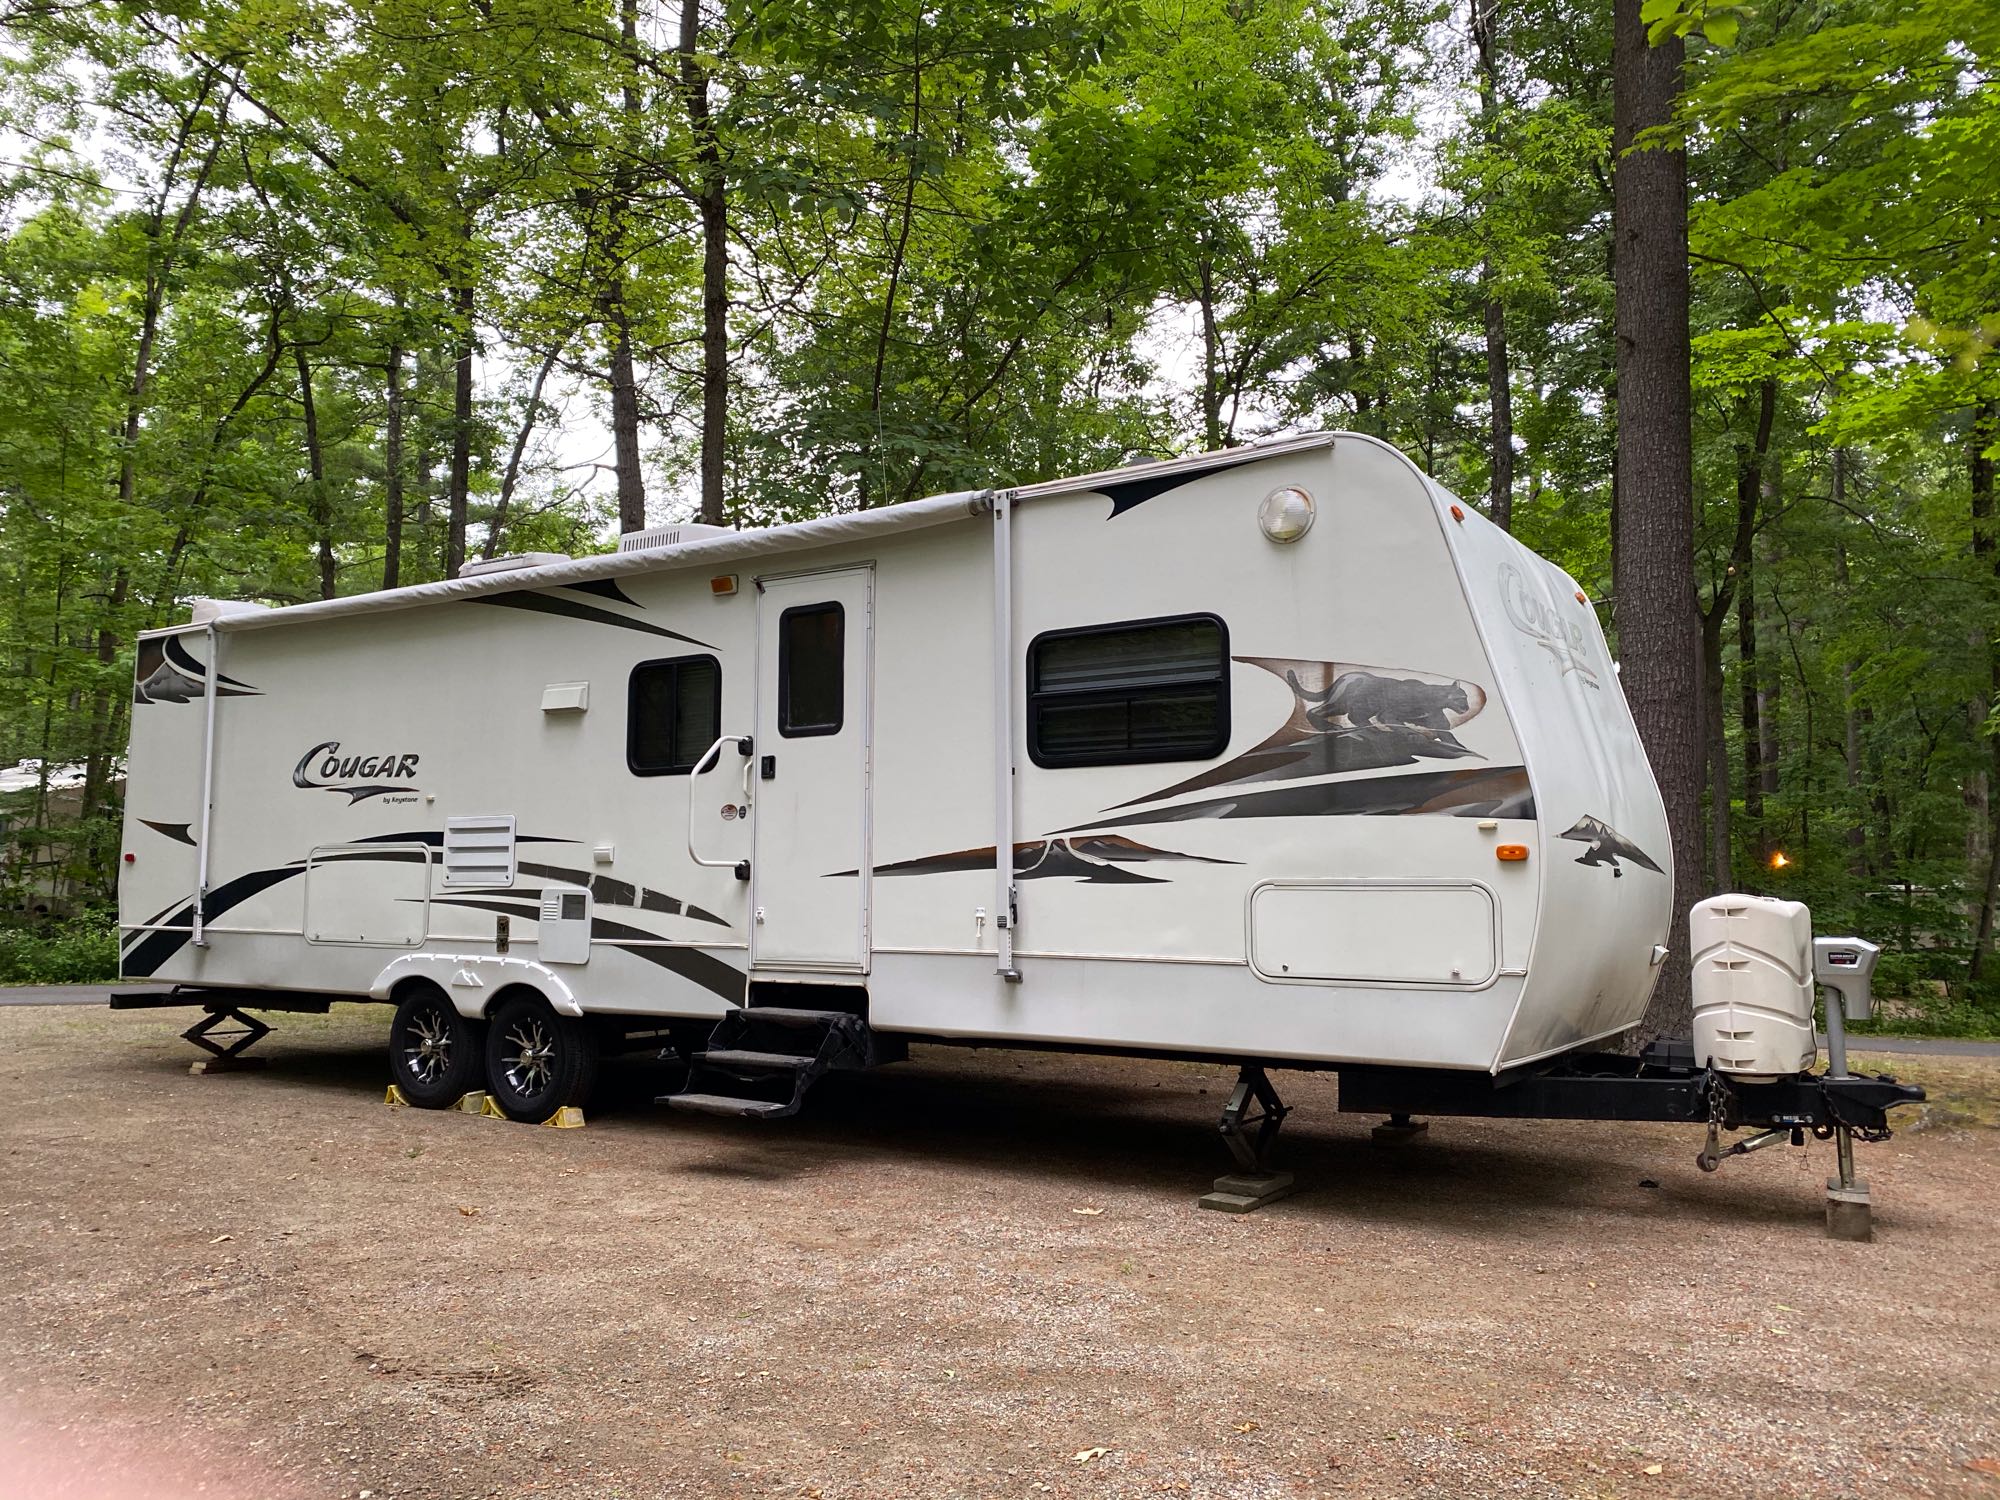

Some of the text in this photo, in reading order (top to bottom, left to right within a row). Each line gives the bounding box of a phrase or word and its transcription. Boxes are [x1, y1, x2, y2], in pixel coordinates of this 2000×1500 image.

[293, 741, 420, 788] COUGAR
[382, 796, 418, 805] by Keystone
